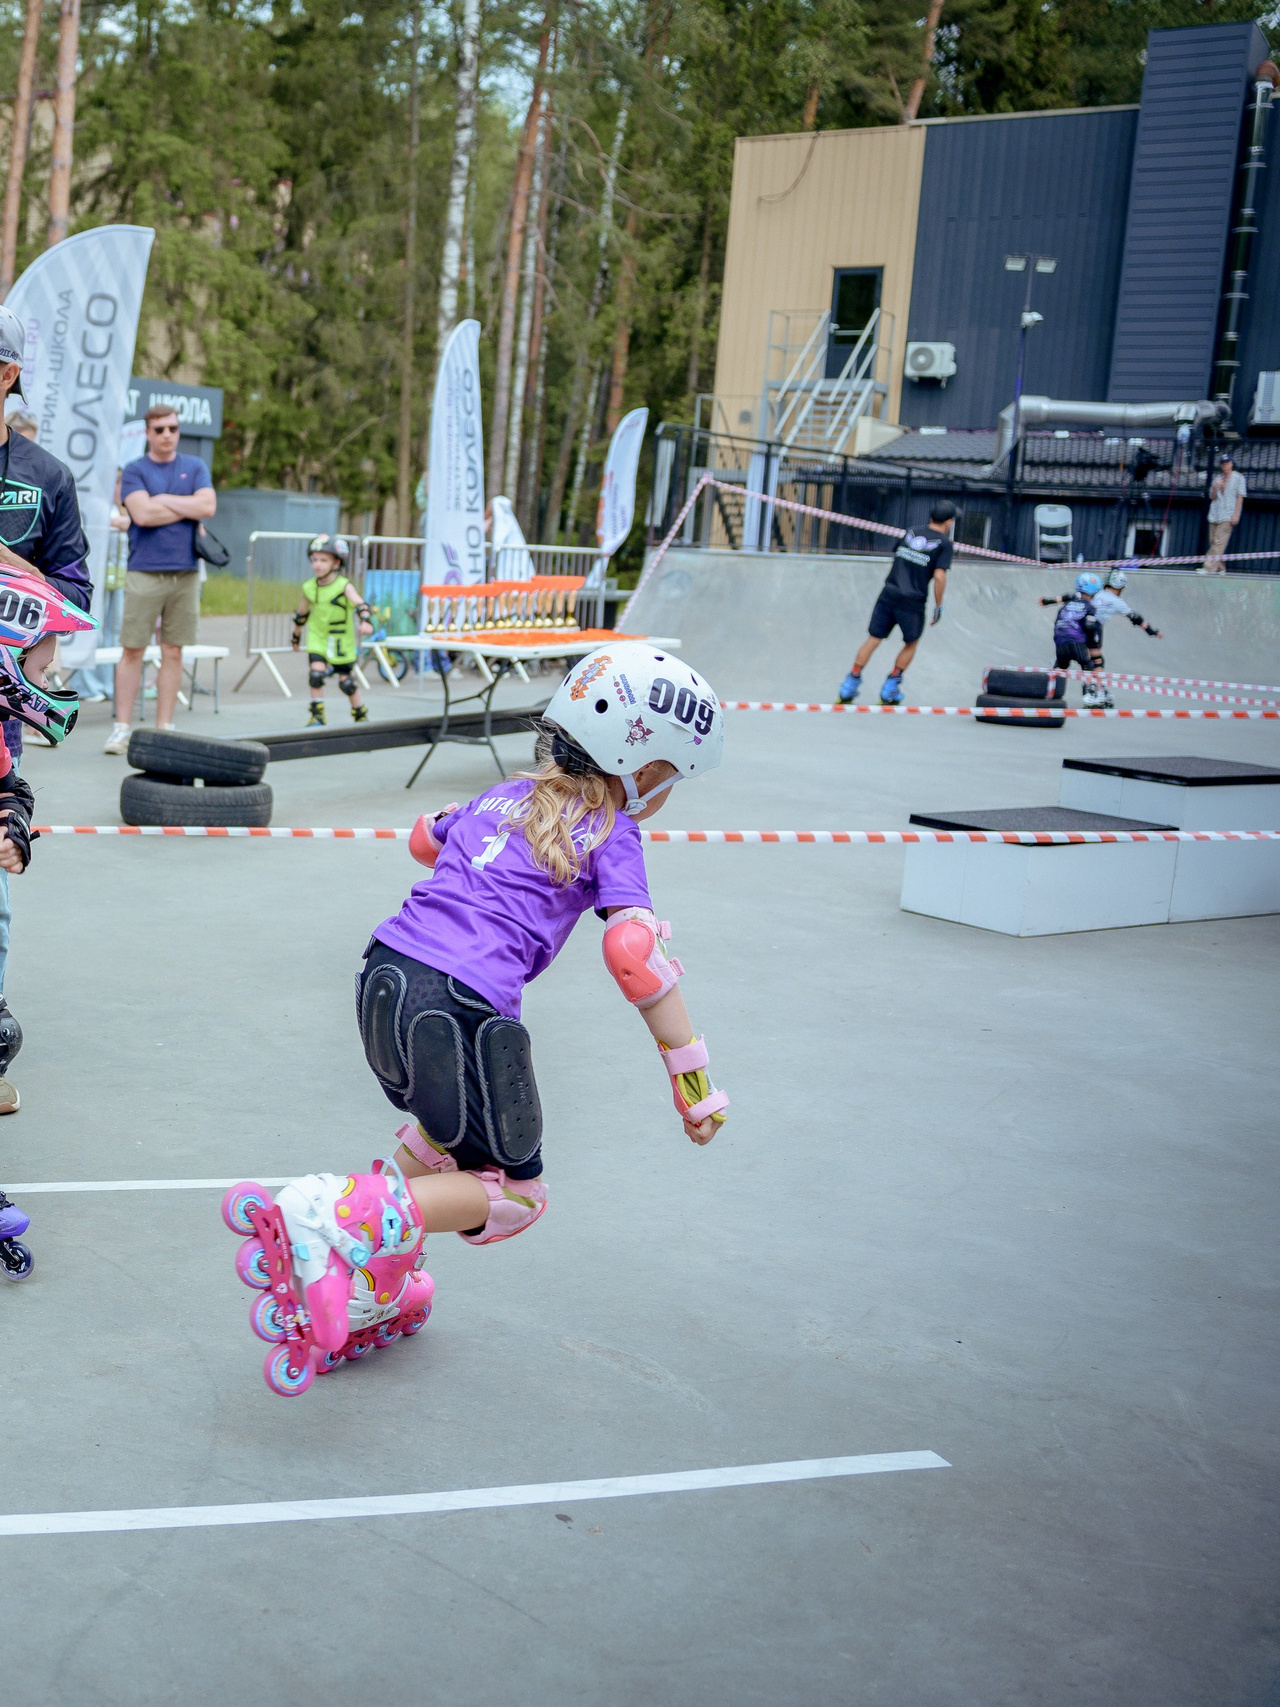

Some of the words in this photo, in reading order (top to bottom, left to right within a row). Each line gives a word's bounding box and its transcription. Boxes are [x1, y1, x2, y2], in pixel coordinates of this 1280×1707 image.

[40, 289, 73, 446] ТРИМ-ШКОЛА
[66, 291, 118, 493] КОЛЕСО
[463, 368, 480, 513] КОЛЕСО
[648, 678, 714, 736] 009
